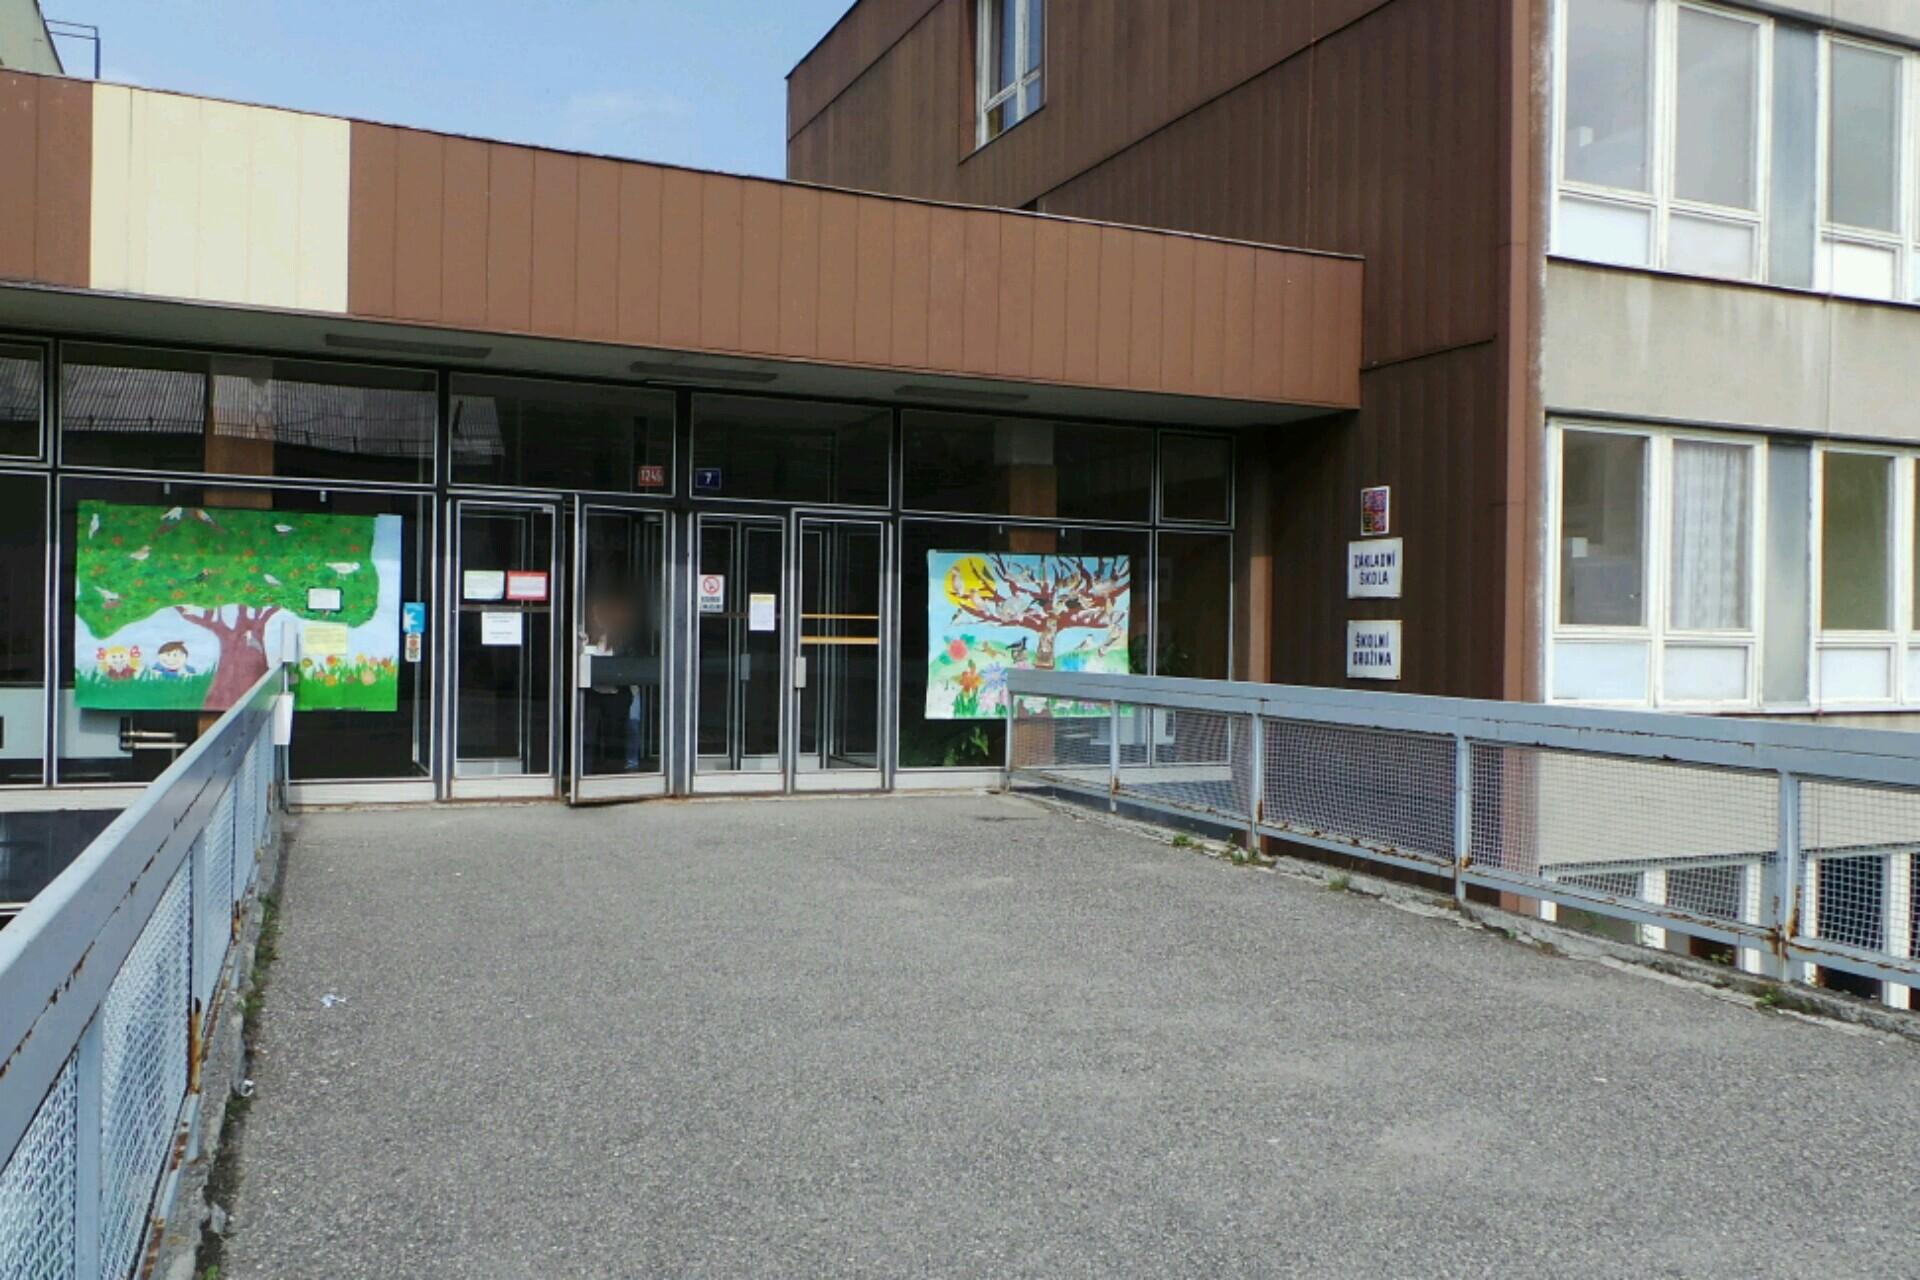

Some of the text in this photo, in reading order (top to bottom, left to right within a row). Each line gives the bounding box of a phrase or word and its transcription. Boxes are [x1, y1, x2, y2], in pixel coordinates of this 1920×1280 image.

[704, 471, 712, 485] 7
[1355, 631, 1390, 649] ŠKOLNÍ
[1352, 649, 1392, 667] DRUŽINA
